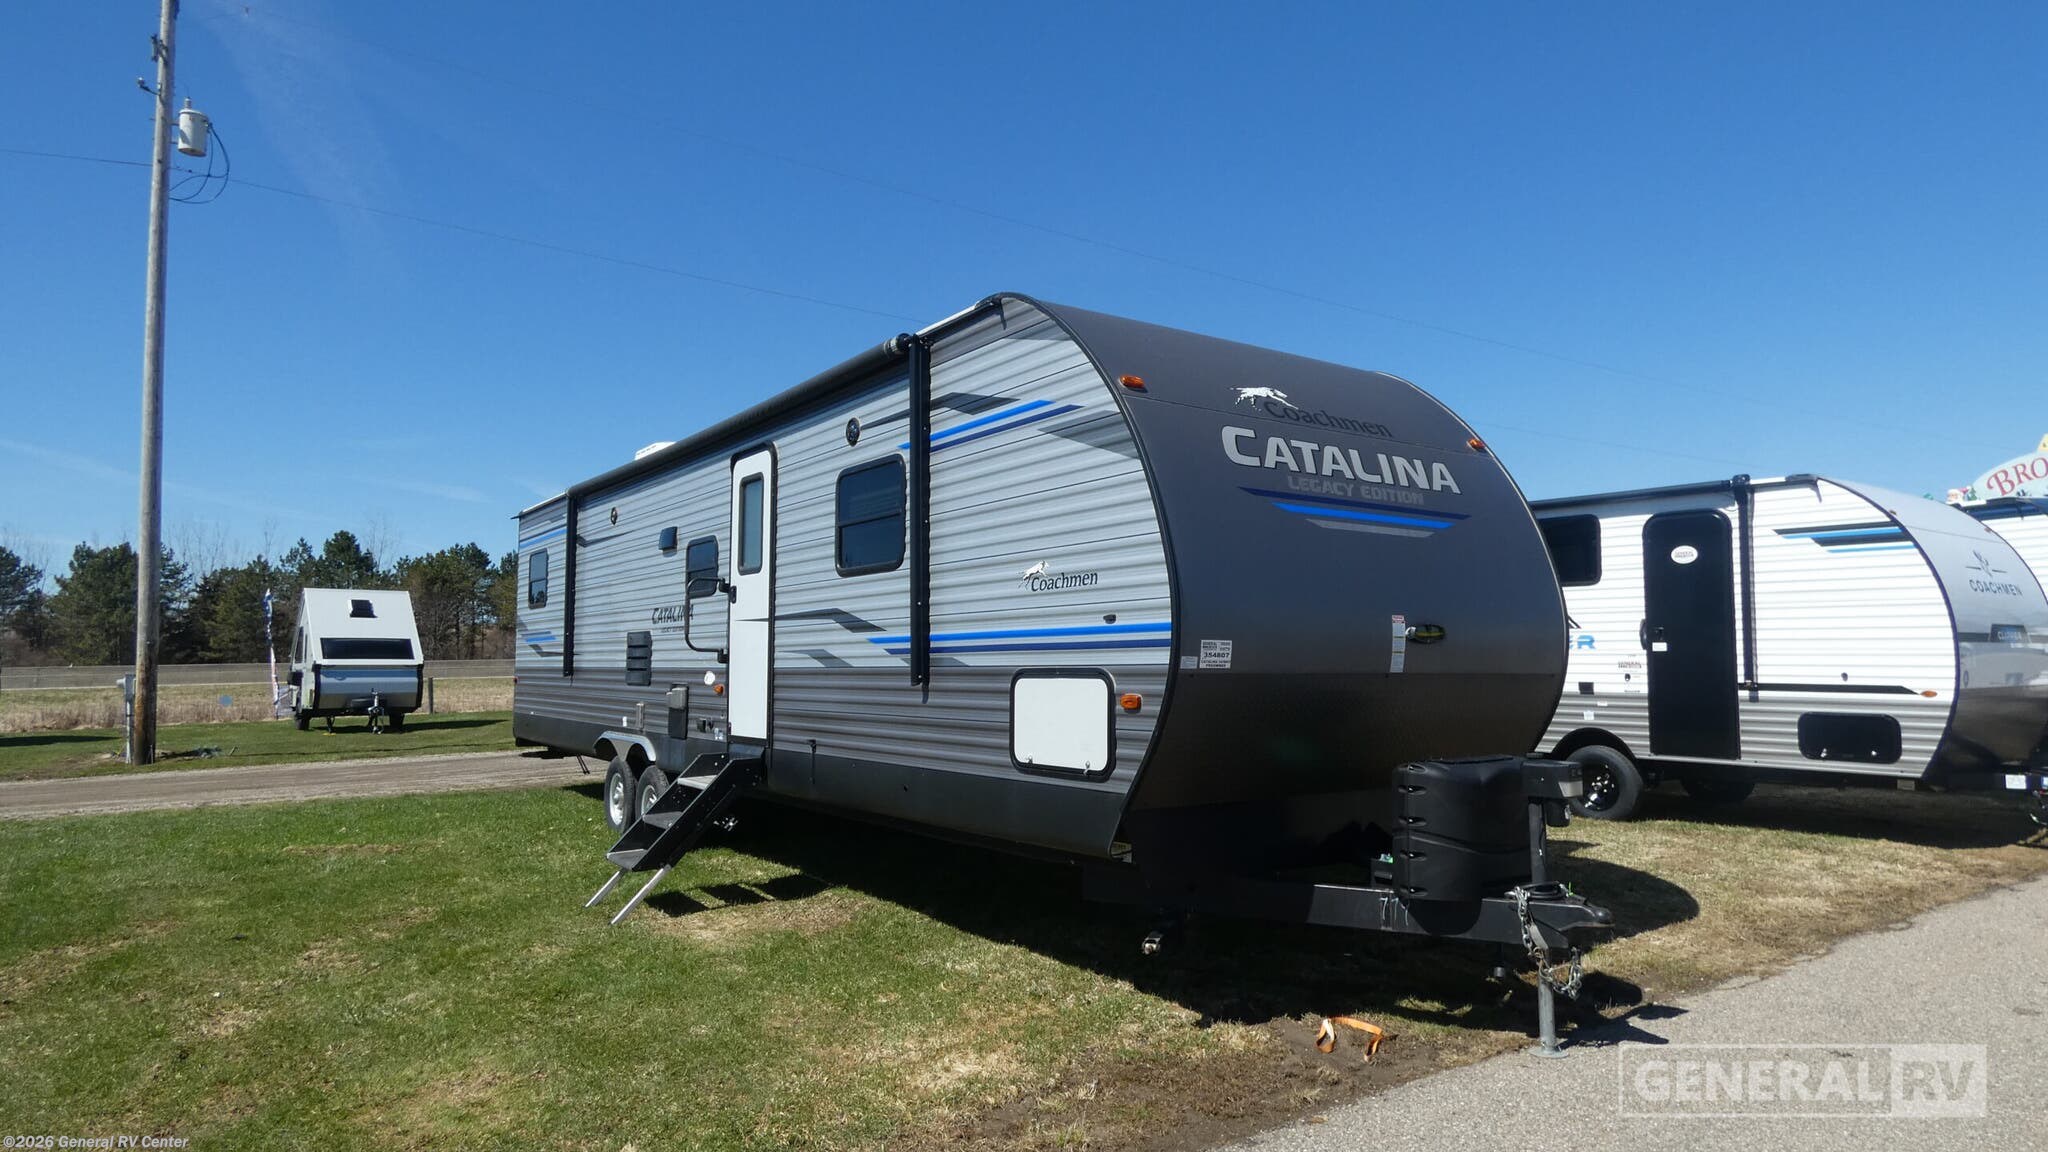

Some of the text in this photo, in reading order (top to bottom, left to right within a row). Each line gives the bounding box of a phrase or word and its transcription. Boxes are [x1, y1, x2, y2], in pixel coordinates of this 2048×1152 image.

[1262, 400, 1394, 438] Coachmen
[1220, 425, 1462, 495] CATALINA
[1288, 475, 1425, 506] LEGACY EDITION
[1031, 572, 1098, 591] Coachmen
[1968, 579, 2024, 597] COACHMEN
